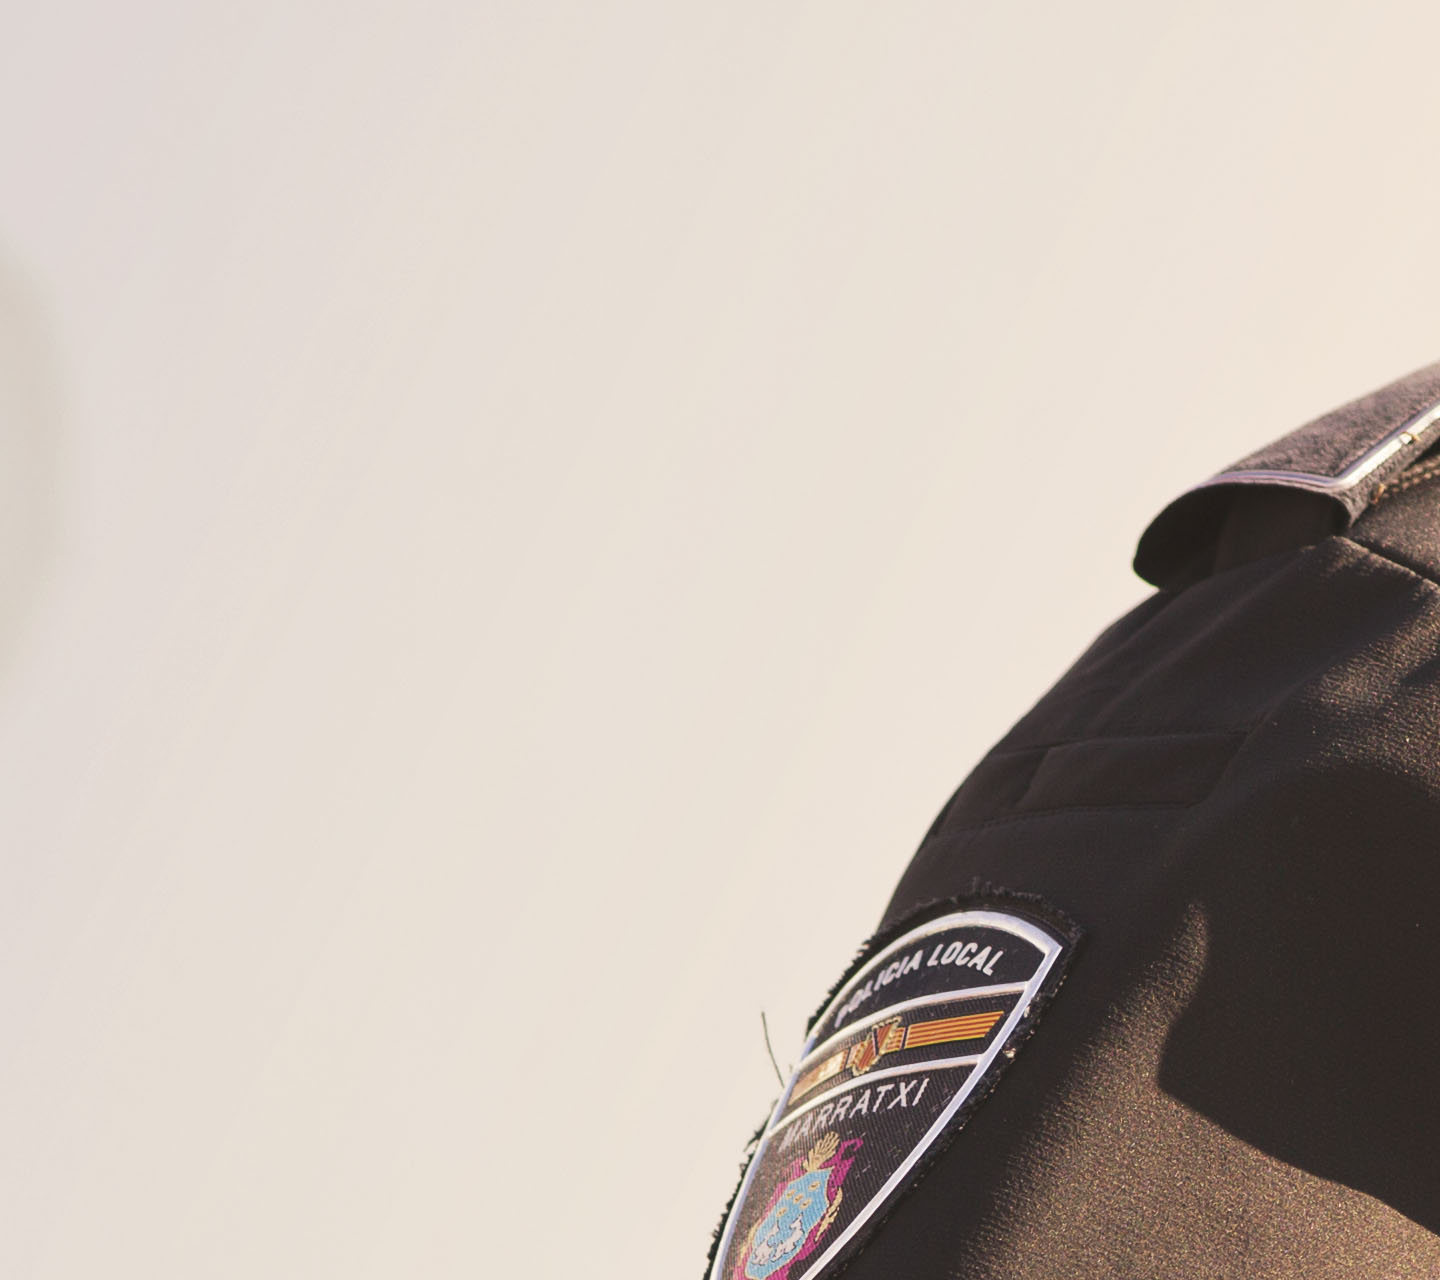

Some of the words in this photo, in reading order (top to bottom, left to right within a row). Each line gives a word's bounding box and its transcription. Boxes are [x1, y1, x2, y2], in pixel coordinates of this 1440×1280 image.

[833, 949, 924, 1029] POLICIA
[926, 941, 1005, 977] LOCAL
[778, 1077, 930, 1152] MARRATXI
